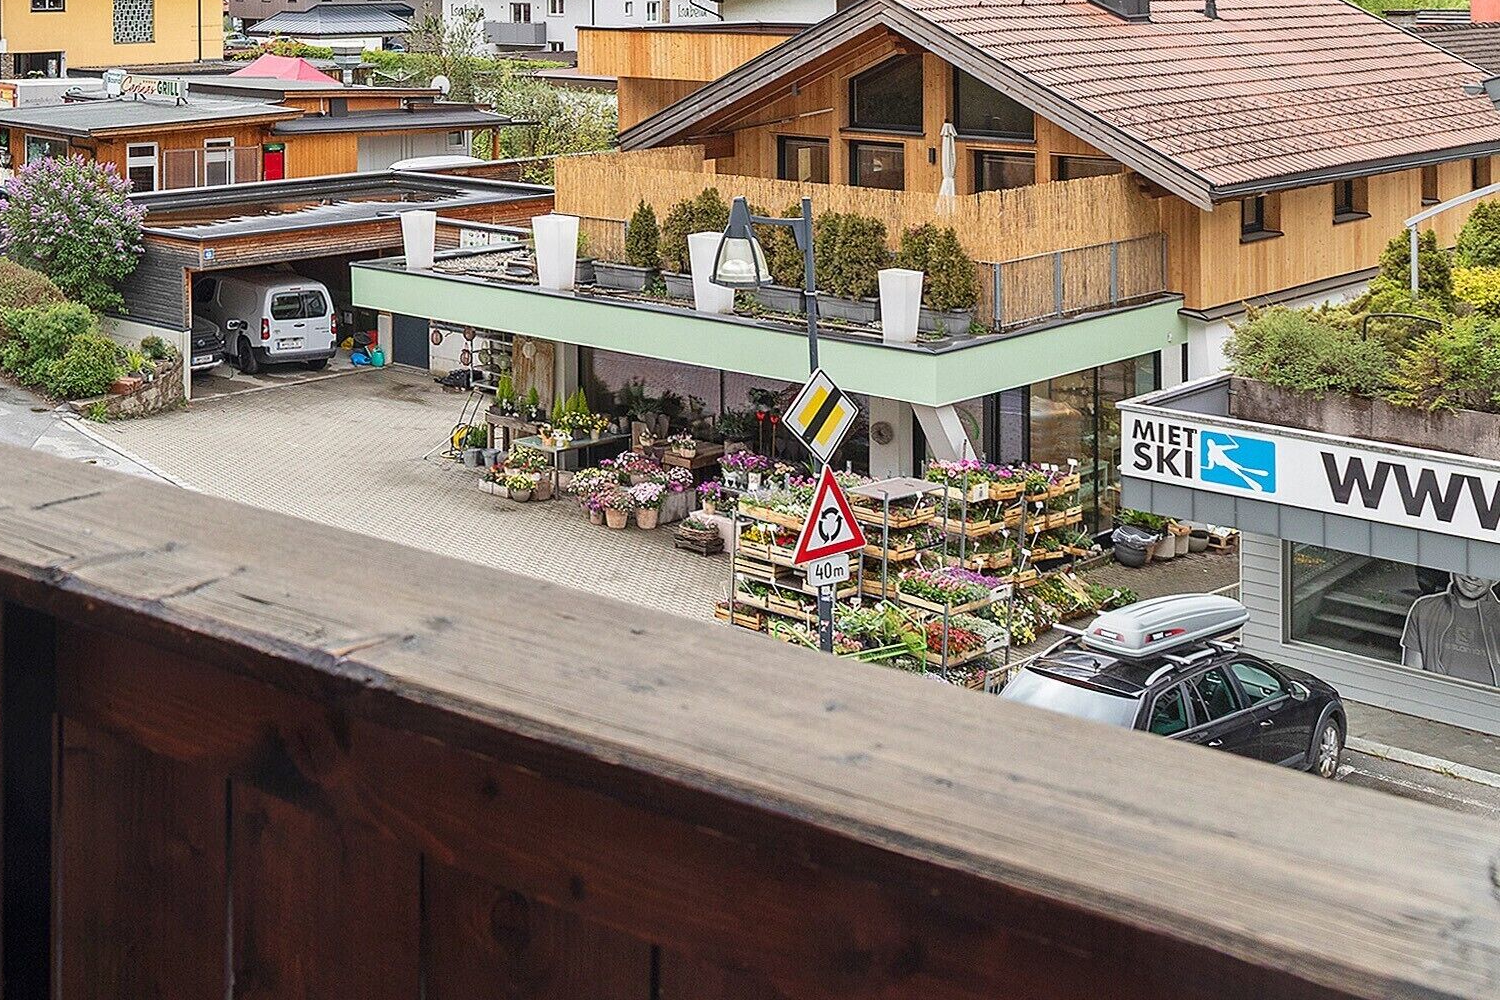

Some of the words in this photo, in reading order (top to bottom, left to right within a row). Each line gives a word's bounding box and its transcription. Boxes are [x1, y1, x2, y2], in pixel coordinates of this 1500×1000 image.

[156, 80, 180, 97] GRILL
[1131, 418, 1198, 449] MIET
[1132, 441, 1194, 480] SKI
[815, 561, 844, 580] 40m
